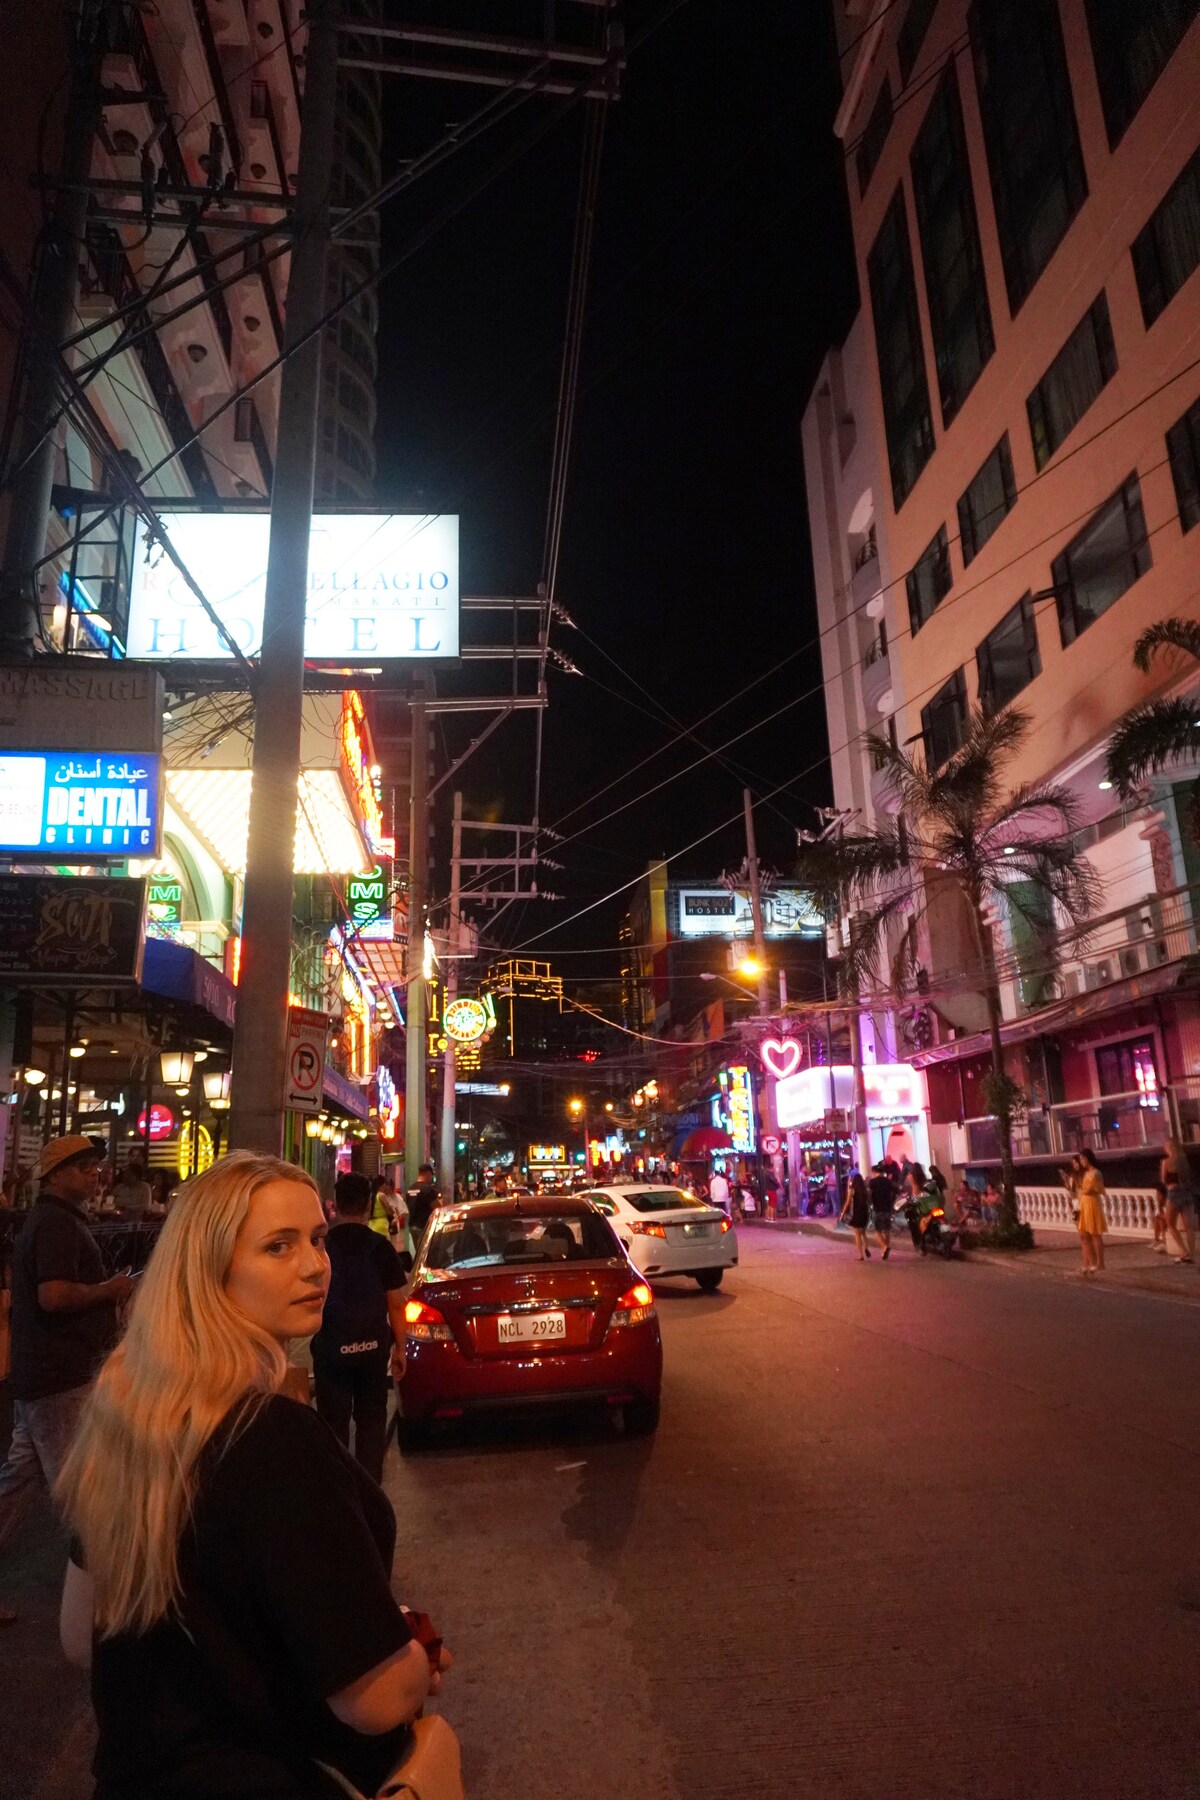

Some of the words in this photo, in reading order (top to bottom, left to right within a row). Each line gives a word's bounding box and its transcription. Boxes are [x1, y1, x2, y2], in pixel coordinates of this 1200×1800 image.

[309, 571, 449, 591] ELLAGIO
[332, 597, 440, 607] MAKATI
[145, 617, 441, 653] HOEL
[54, 758, 102, 783] أسنان
[107, 762, 148, 784] عيادة
[46, 786, 151, 827] DENTAL
[45, 826, 150, 845] CLINIC
[688, 898, 710, 907] BUNK
[291, 1023, 300, 1037] NO
[301, 1025, 325, 1040] PARKING
[500, 1322, 523, 1337] NCL
[532, 1320, 564, 1335] 2928
[340, 1340, 378, 1354] adidas
